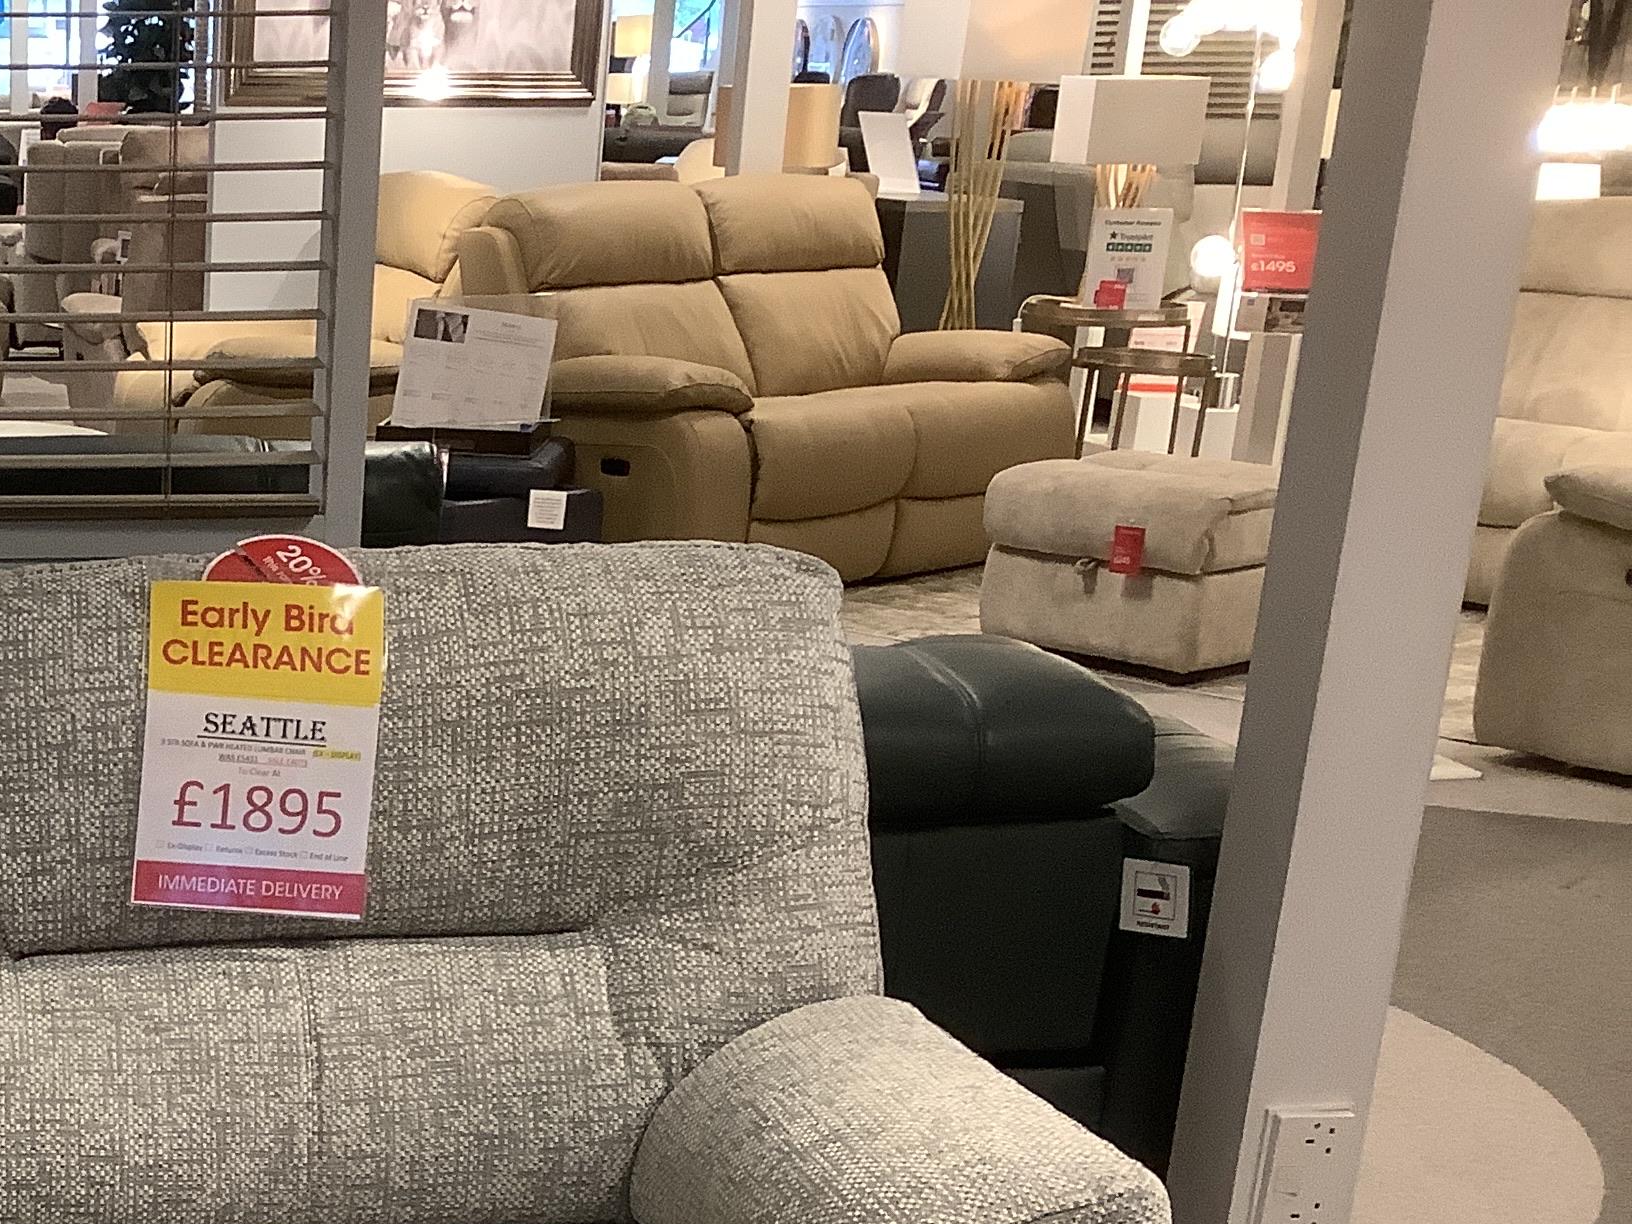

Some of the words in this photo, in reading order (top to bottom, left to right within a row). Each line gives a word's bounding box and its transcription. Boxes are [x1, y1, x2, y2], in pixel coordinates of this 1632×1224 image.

[275, 544, 327, 586] 20%
[179, 599, 272, 637] Early
[284, 603, 354, 635] Bird
[162, 638, 371, 676] CLEARANCE
[181, 739, 200, 748] SOFA
[202, 712, 328, 743] SEATTLE
[171, 779, 343, 838] £1895
[158, 873, 256, 896] IMMEDIATE
[261, 880, 344, 901] DELIVERY
